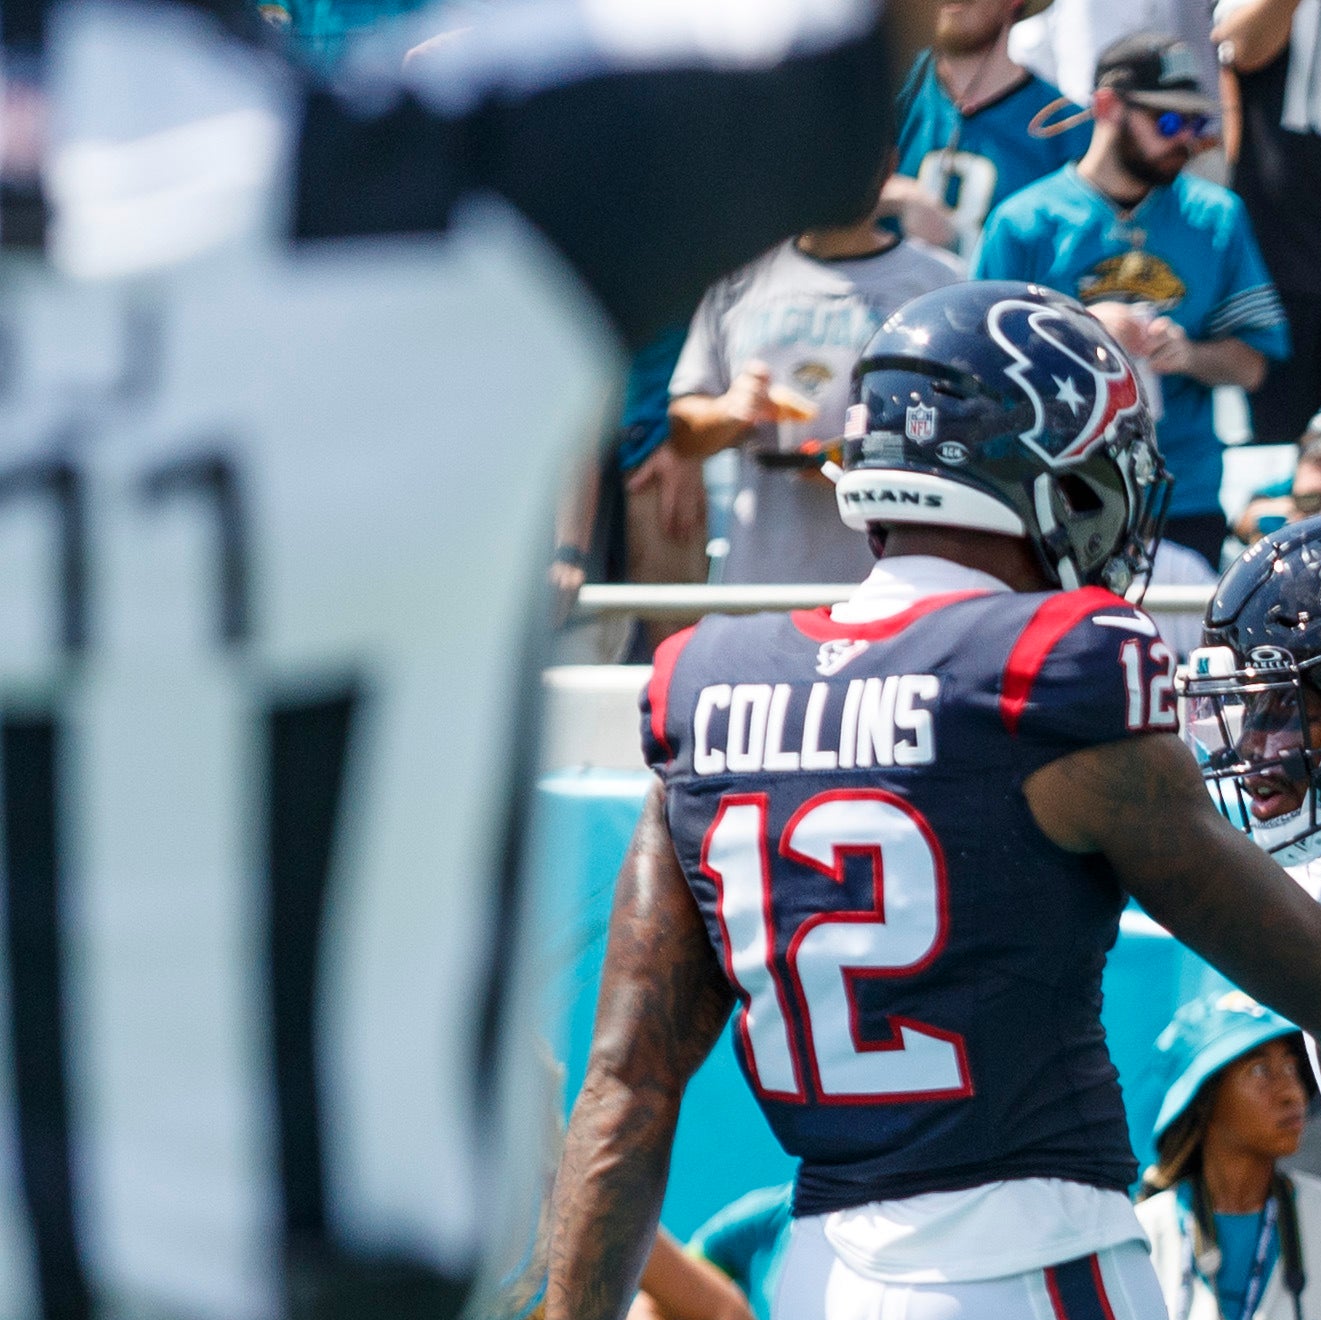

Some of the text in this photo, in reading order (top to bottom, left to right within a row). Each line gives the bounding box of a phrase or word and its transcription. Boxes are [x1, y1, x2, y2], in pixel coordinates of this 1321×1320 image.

[694, 673, 940, 775] COLLINS
[1118, 638, 1178, 732] 12
[702, 788, 974, 1105] 12
